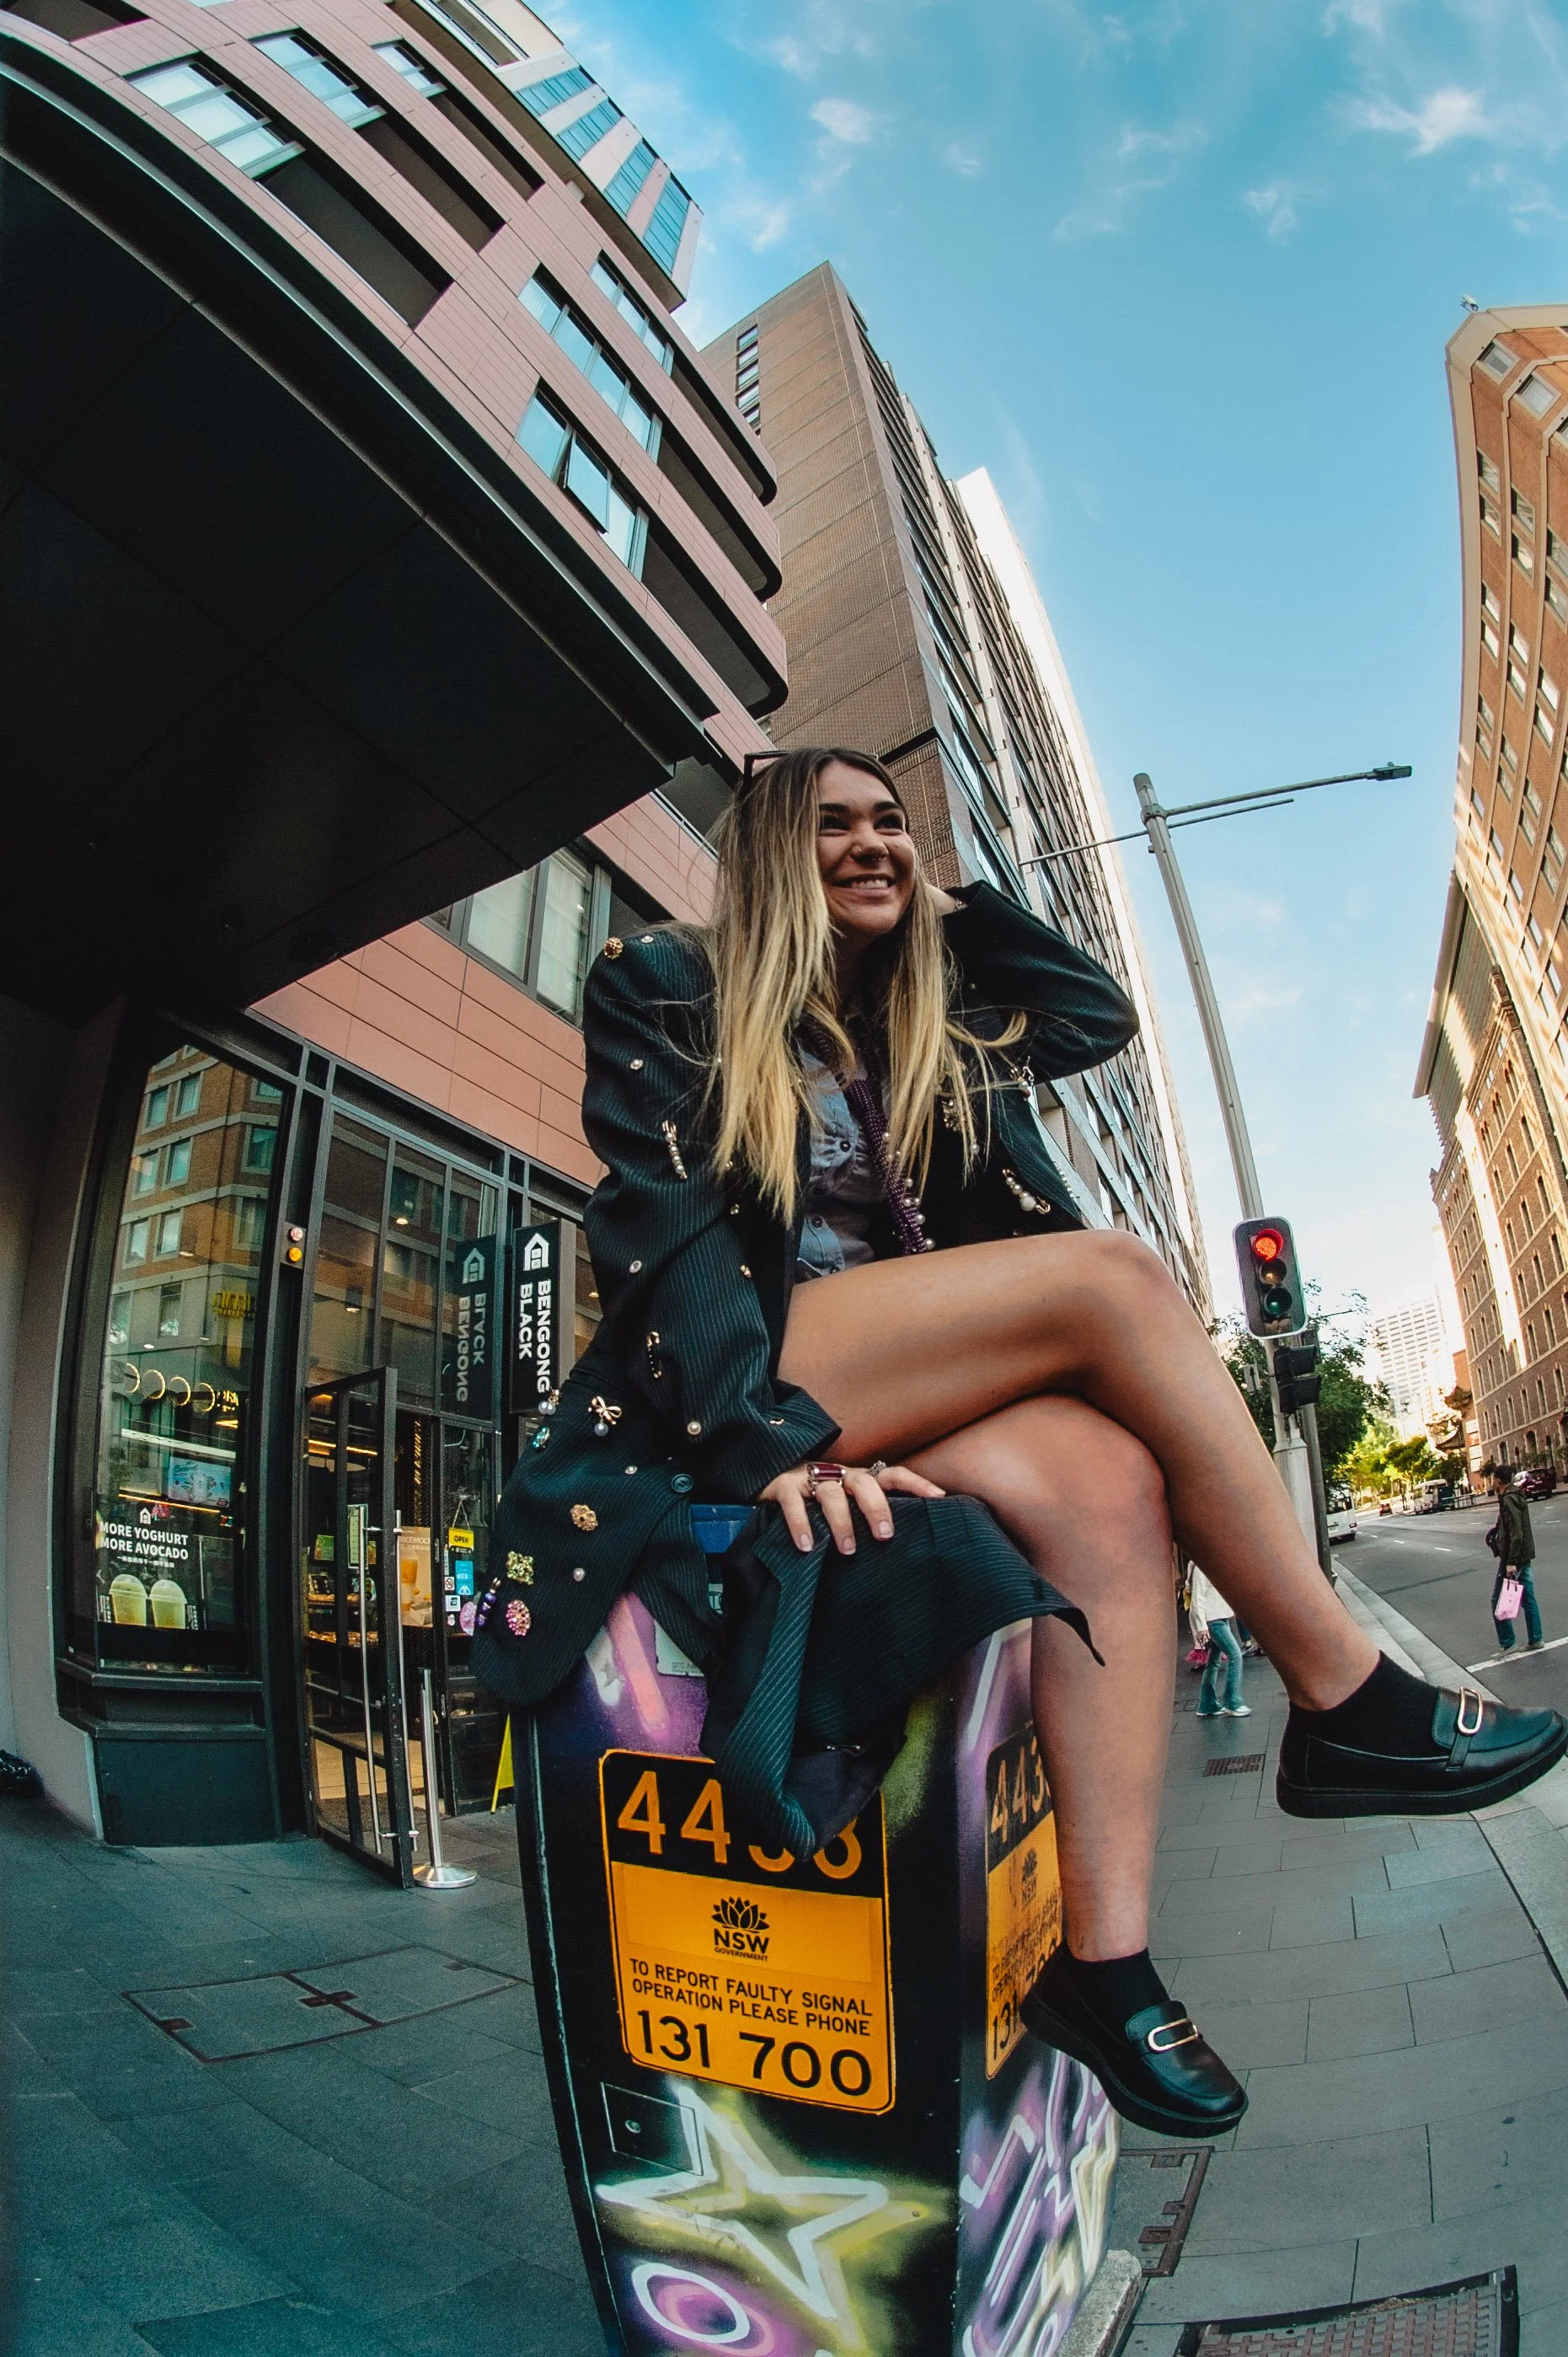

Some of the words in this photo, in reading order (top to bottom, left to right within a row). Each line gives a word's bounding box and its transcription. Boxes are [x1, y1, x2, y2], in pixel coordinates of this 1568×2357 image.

[518, 1282, 533, 1360] BLACK
[537, 1278, 552, 1394] BENGONG
[100, 1521, 132, 1538] MORE
[134, 1527, 189, 1546] YOGHURT
[100, 1538, 133, 1552] MORE
[135, 1542, 189, 1560] AVOCADO
[453, 1535, 469, 1544] OPEN
[990, 1735, 1052, 1844] 443
[714, 1927, 769, 1954] NSW
[714, 1947, 768, 1962] GOVERNMENT
[629, 1958, 649, 1976] TO
[655, 1963, 719, 1991] REPORT
[726, 1978, 793, 2005] FAULTY
[802, 1991, 873, 2017] SIGNAL
[632, 1978, 723, 2011] OPERATION
[729, 1999, 800, 2026] PLEASE
[805, 2011, 870, 2037] PHONE
[637, 2009, 711, 2069] 131
[739, 2031, 872, 2097] 700
[993, 1990, 1018, 2061] 131
